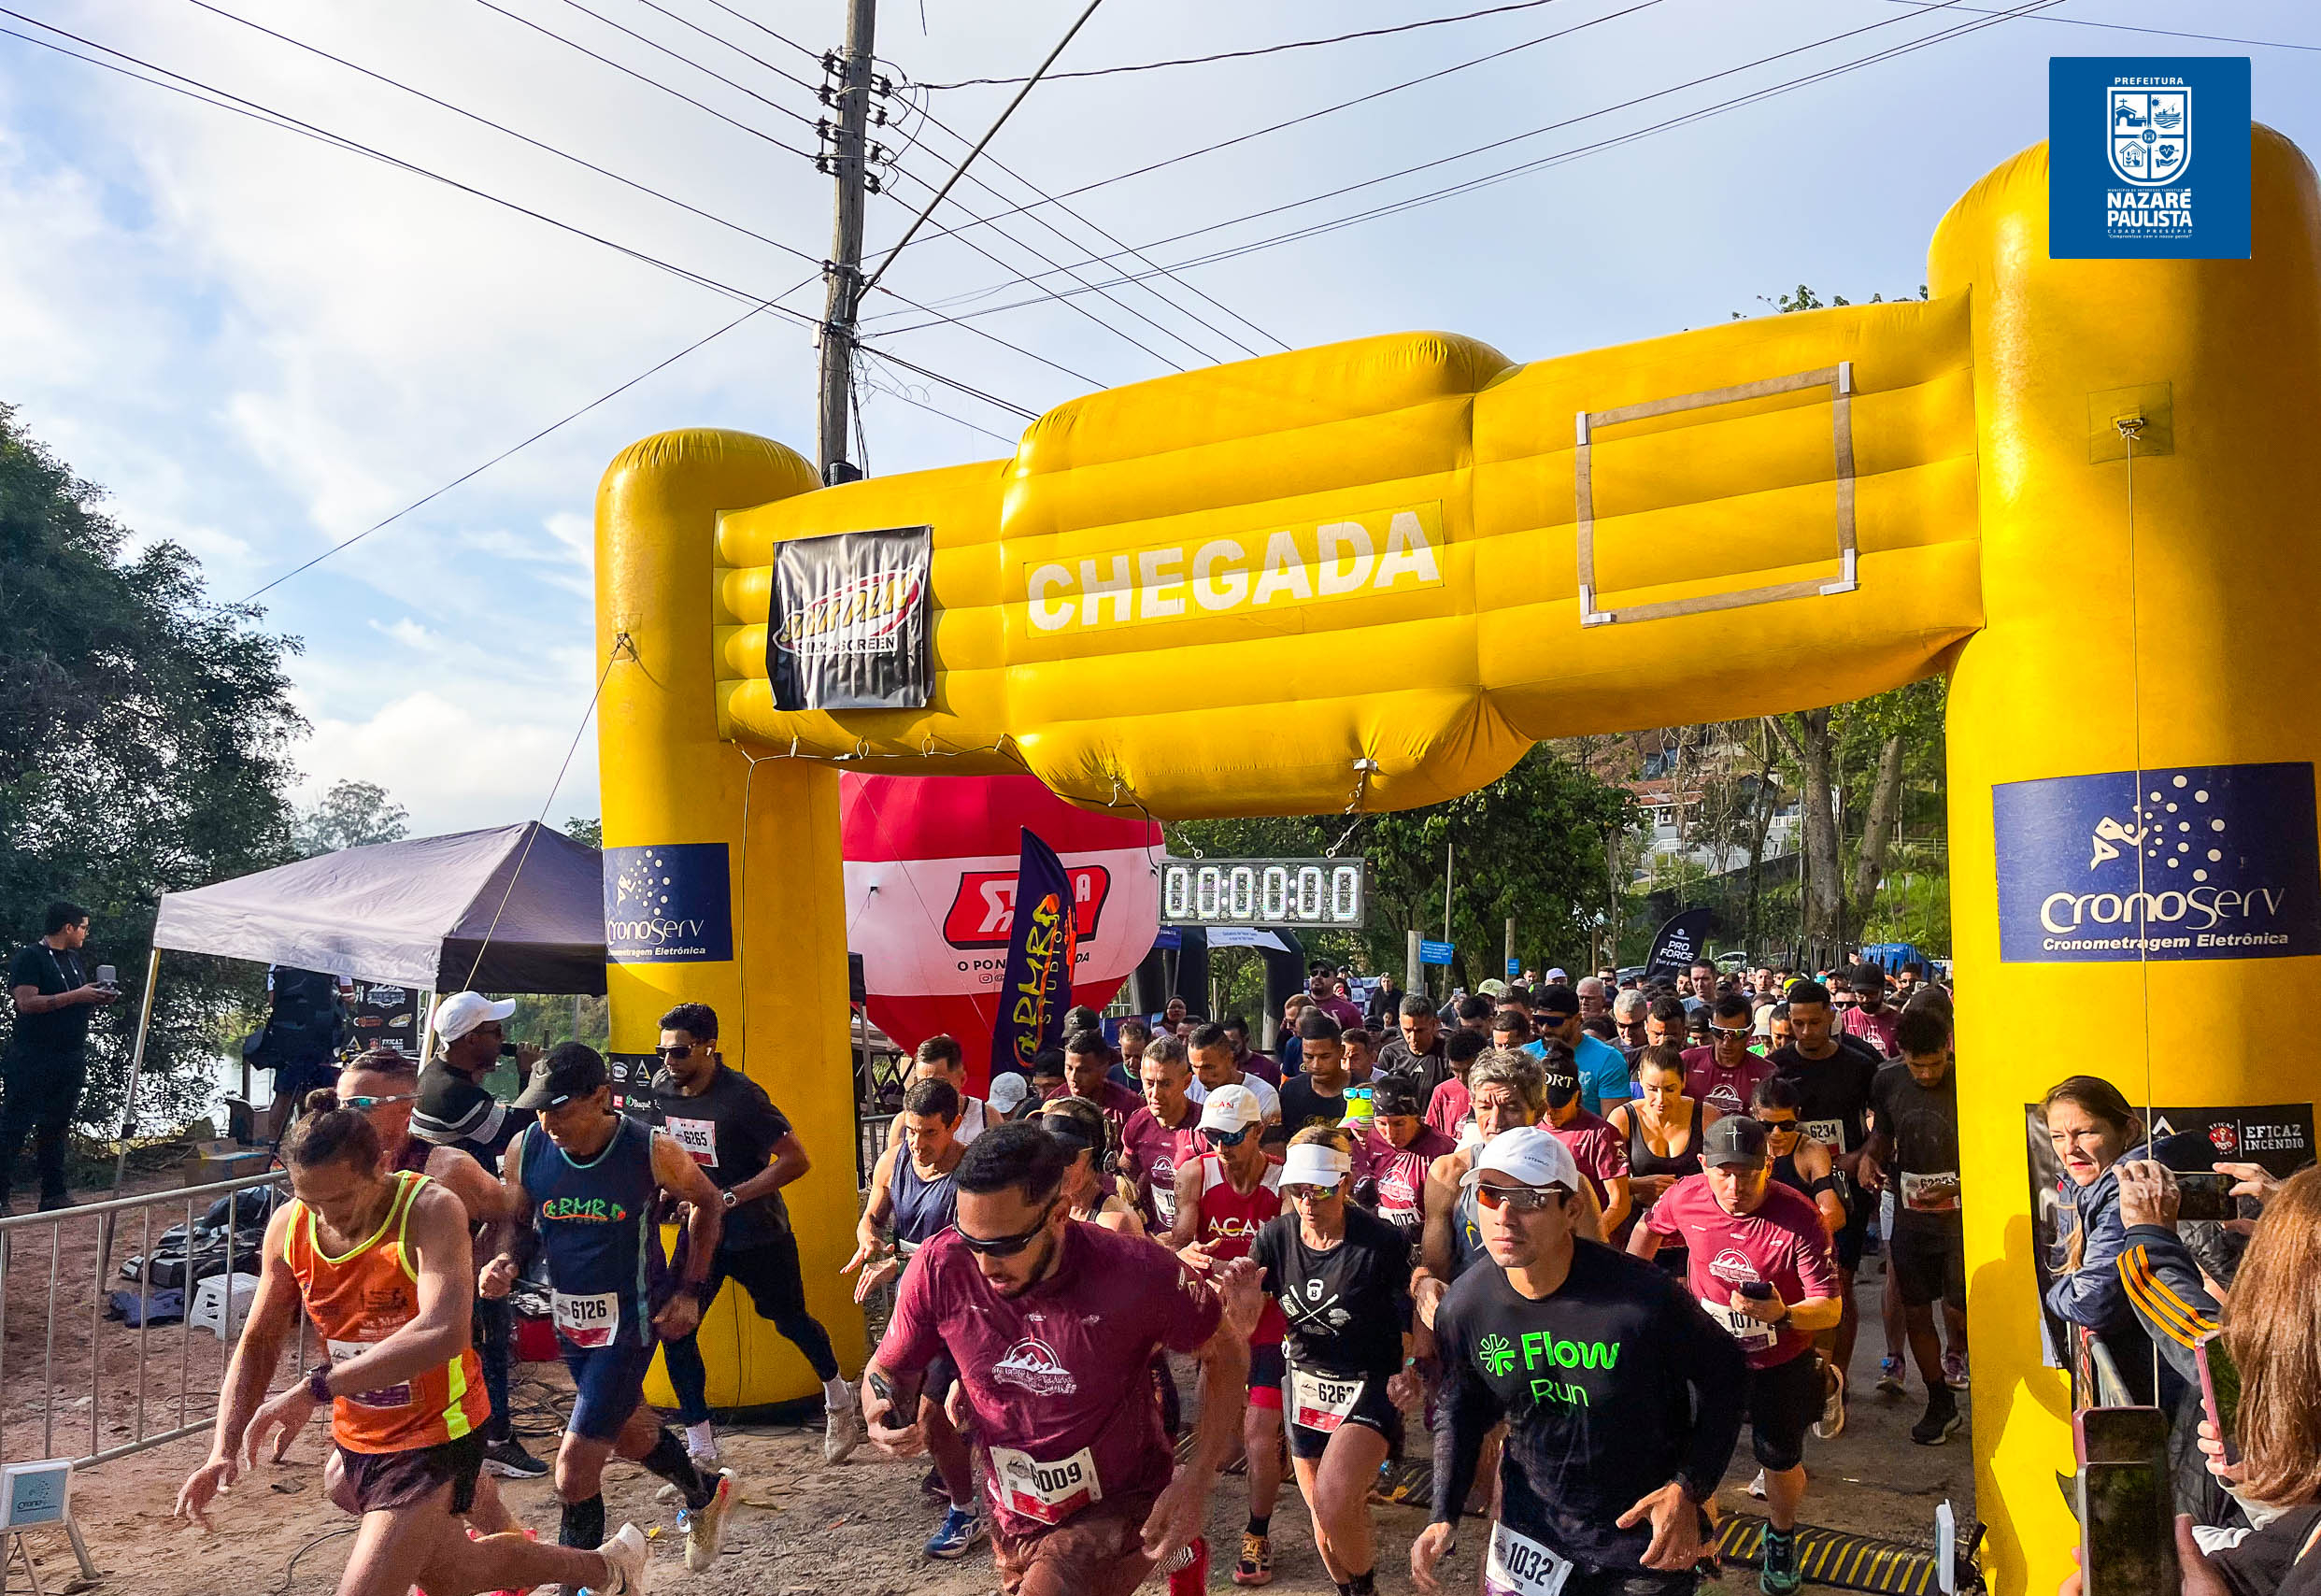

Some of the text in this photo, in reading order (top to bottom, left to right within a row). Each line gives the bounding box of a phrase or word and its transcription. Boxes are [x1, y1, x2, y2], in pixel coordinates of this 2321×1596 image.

[1028, 510, 1440, 631] CHEGADA
[655, 946, 706, 956] Eletrônica
[1668, 940, 1690, 951] PRO
[2043, 933, 2288, 952] Cronometragem Eletrônica
[958, 952, 1089, 971] O PON DA
[1660, 948, 1694, 962] FORCE
[683, 1131, 708, 1147] 6265
[1810, 1123, 1837, 1139] 6234
[2245, 1124, 2302, 1139] EFICAZ
[1165, 1193, 1176, 1208] 10
[571, 1299, 607, 1320] 6126
[1521, 1331, 1621, 1371] Flow
[1530, 1378, 1589, 1407] Run
[1030, 1461, 1082, 1493] 6009
[1506, 1542, 1555, 1587] 1032
